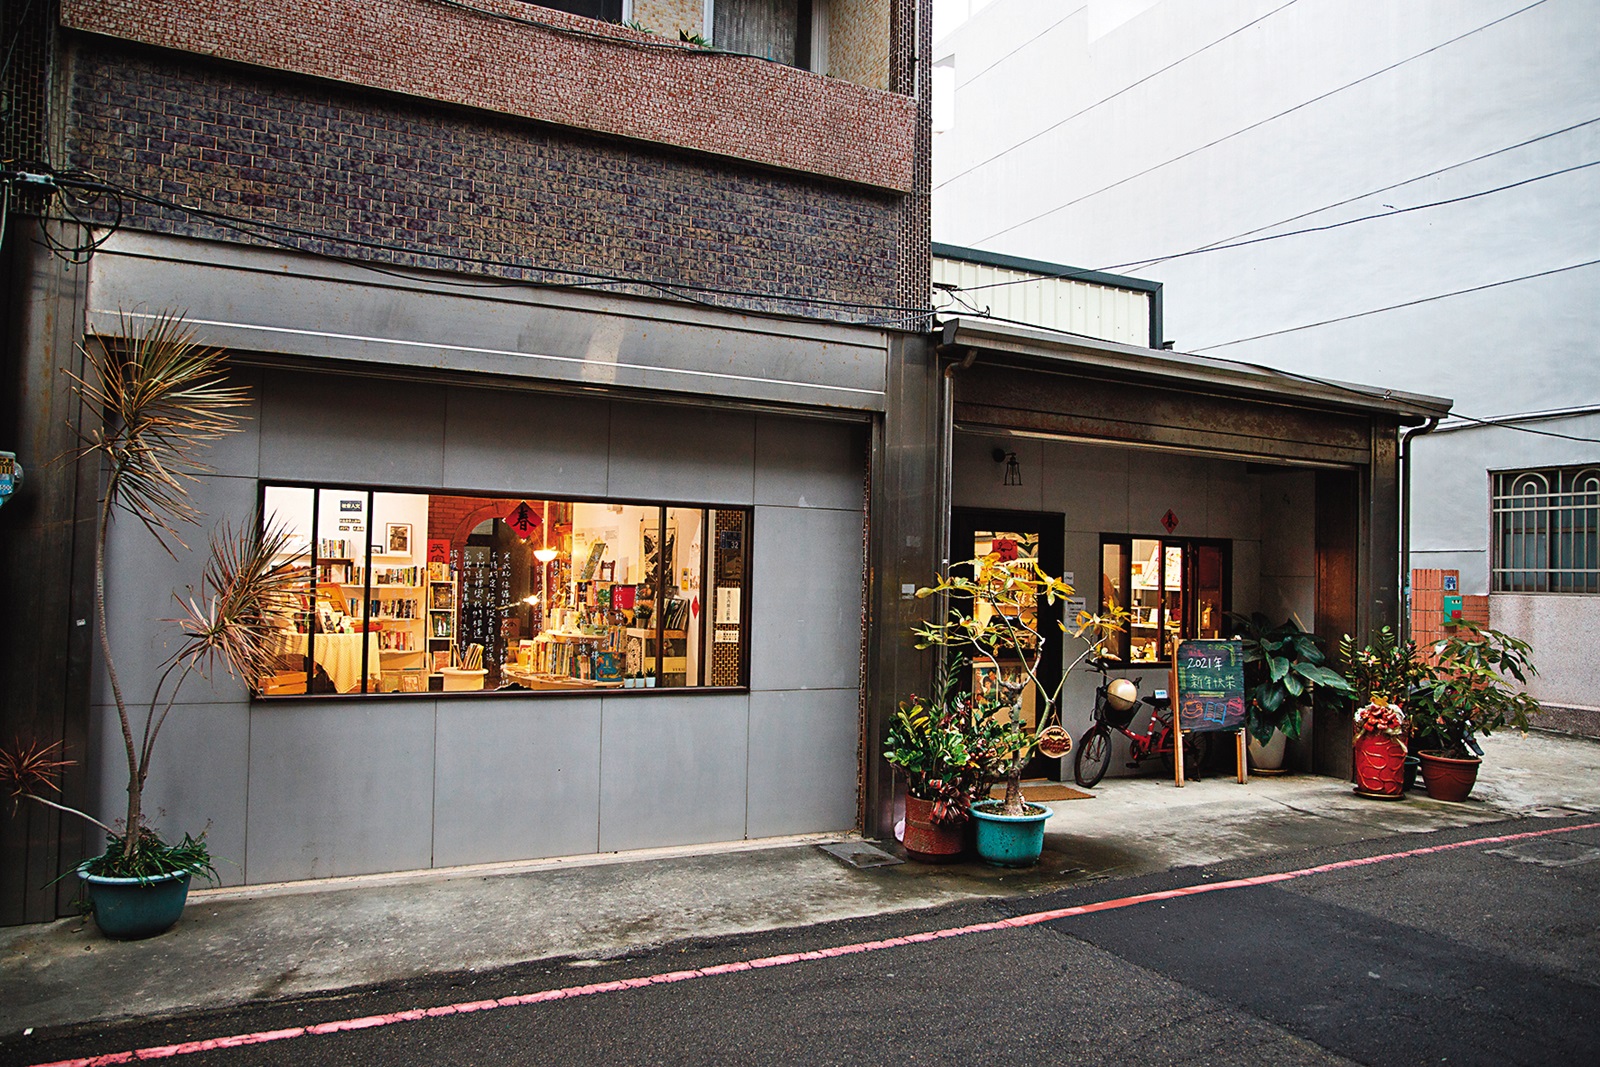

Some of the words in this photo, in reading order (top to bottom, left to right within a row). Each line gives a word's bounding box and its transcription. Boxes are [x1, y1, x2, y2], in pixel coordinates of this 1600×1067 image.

[512, 508, 537, 531] 春
[730, 540, 739, 549] 32
[1187, 656, 1223, 671] 2021年
[1190, 673, 1236, 690] 新年快樂
